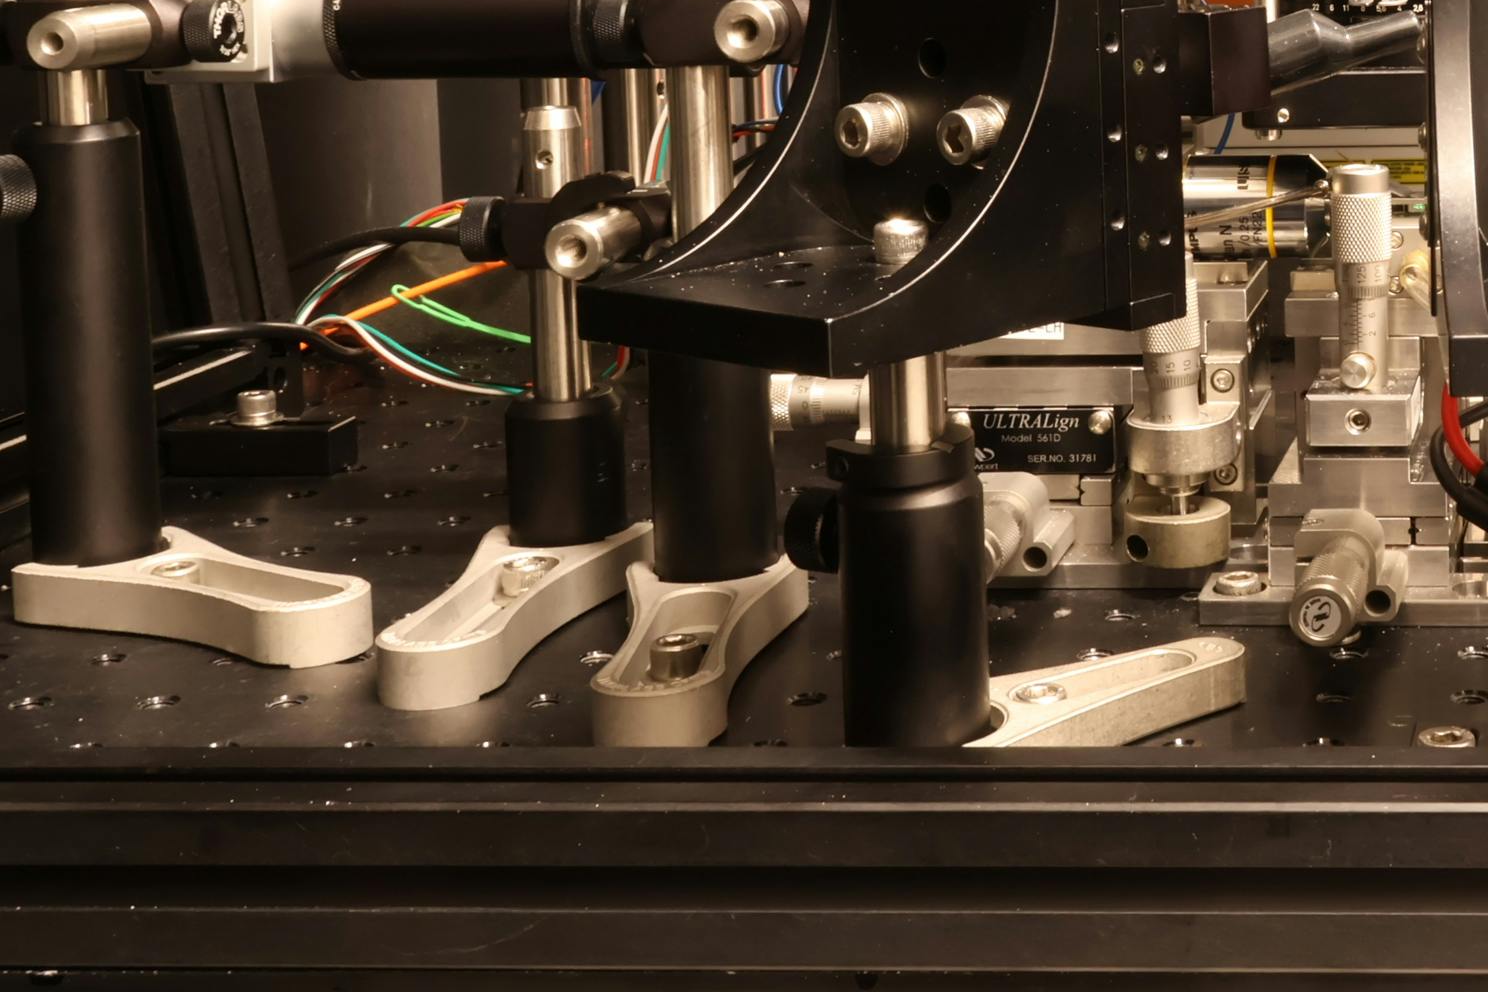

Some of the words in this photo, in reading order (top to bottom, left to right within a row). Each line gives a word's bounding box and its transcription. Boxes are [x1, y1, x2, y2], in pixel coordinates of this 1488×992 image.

[983, 413, 1080, 432] ULTRALign
[1001, 434, 1033, 443] Model
[1037, 433, 1062, 443] 561D
[1069, 454, 1097, 463] 31781
